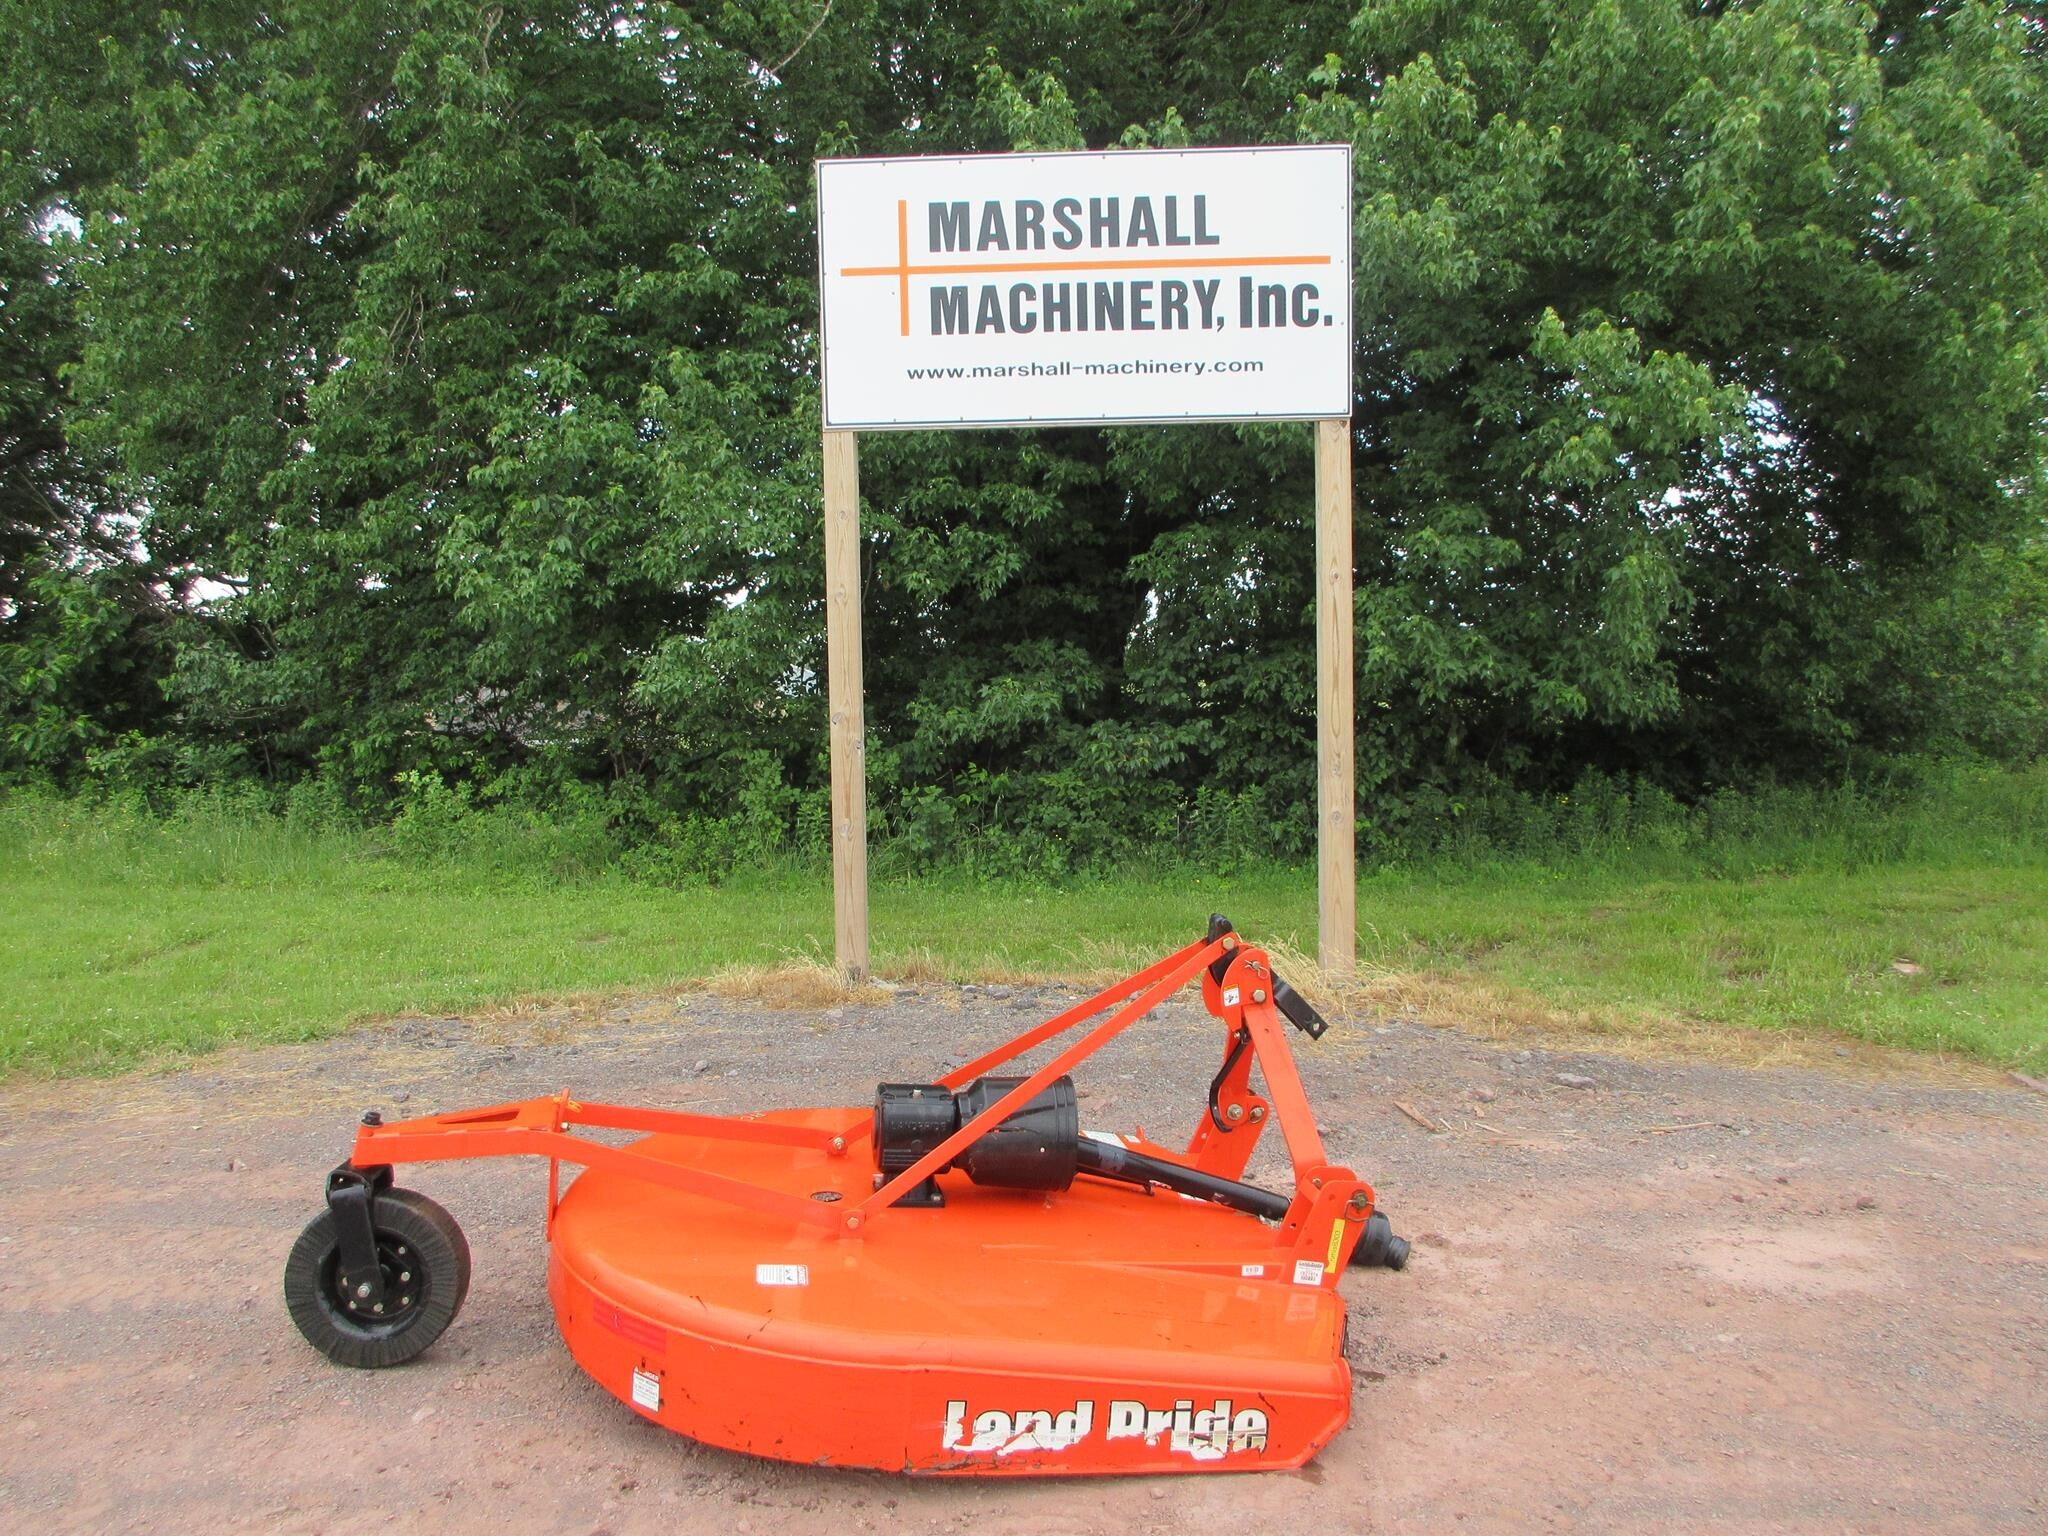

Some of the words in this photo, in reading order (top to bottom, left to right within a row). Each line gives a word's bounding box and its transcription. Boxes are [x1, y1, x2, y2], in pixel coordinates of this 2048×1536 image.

[928, 194, 1220, 252] MARSHALL
[930, 279, 1225, 336] MACHINERY,
[1239, 275, 1333, 328] Inc.
[906, 358, 1264, 380] www.marshall-machinery.com
